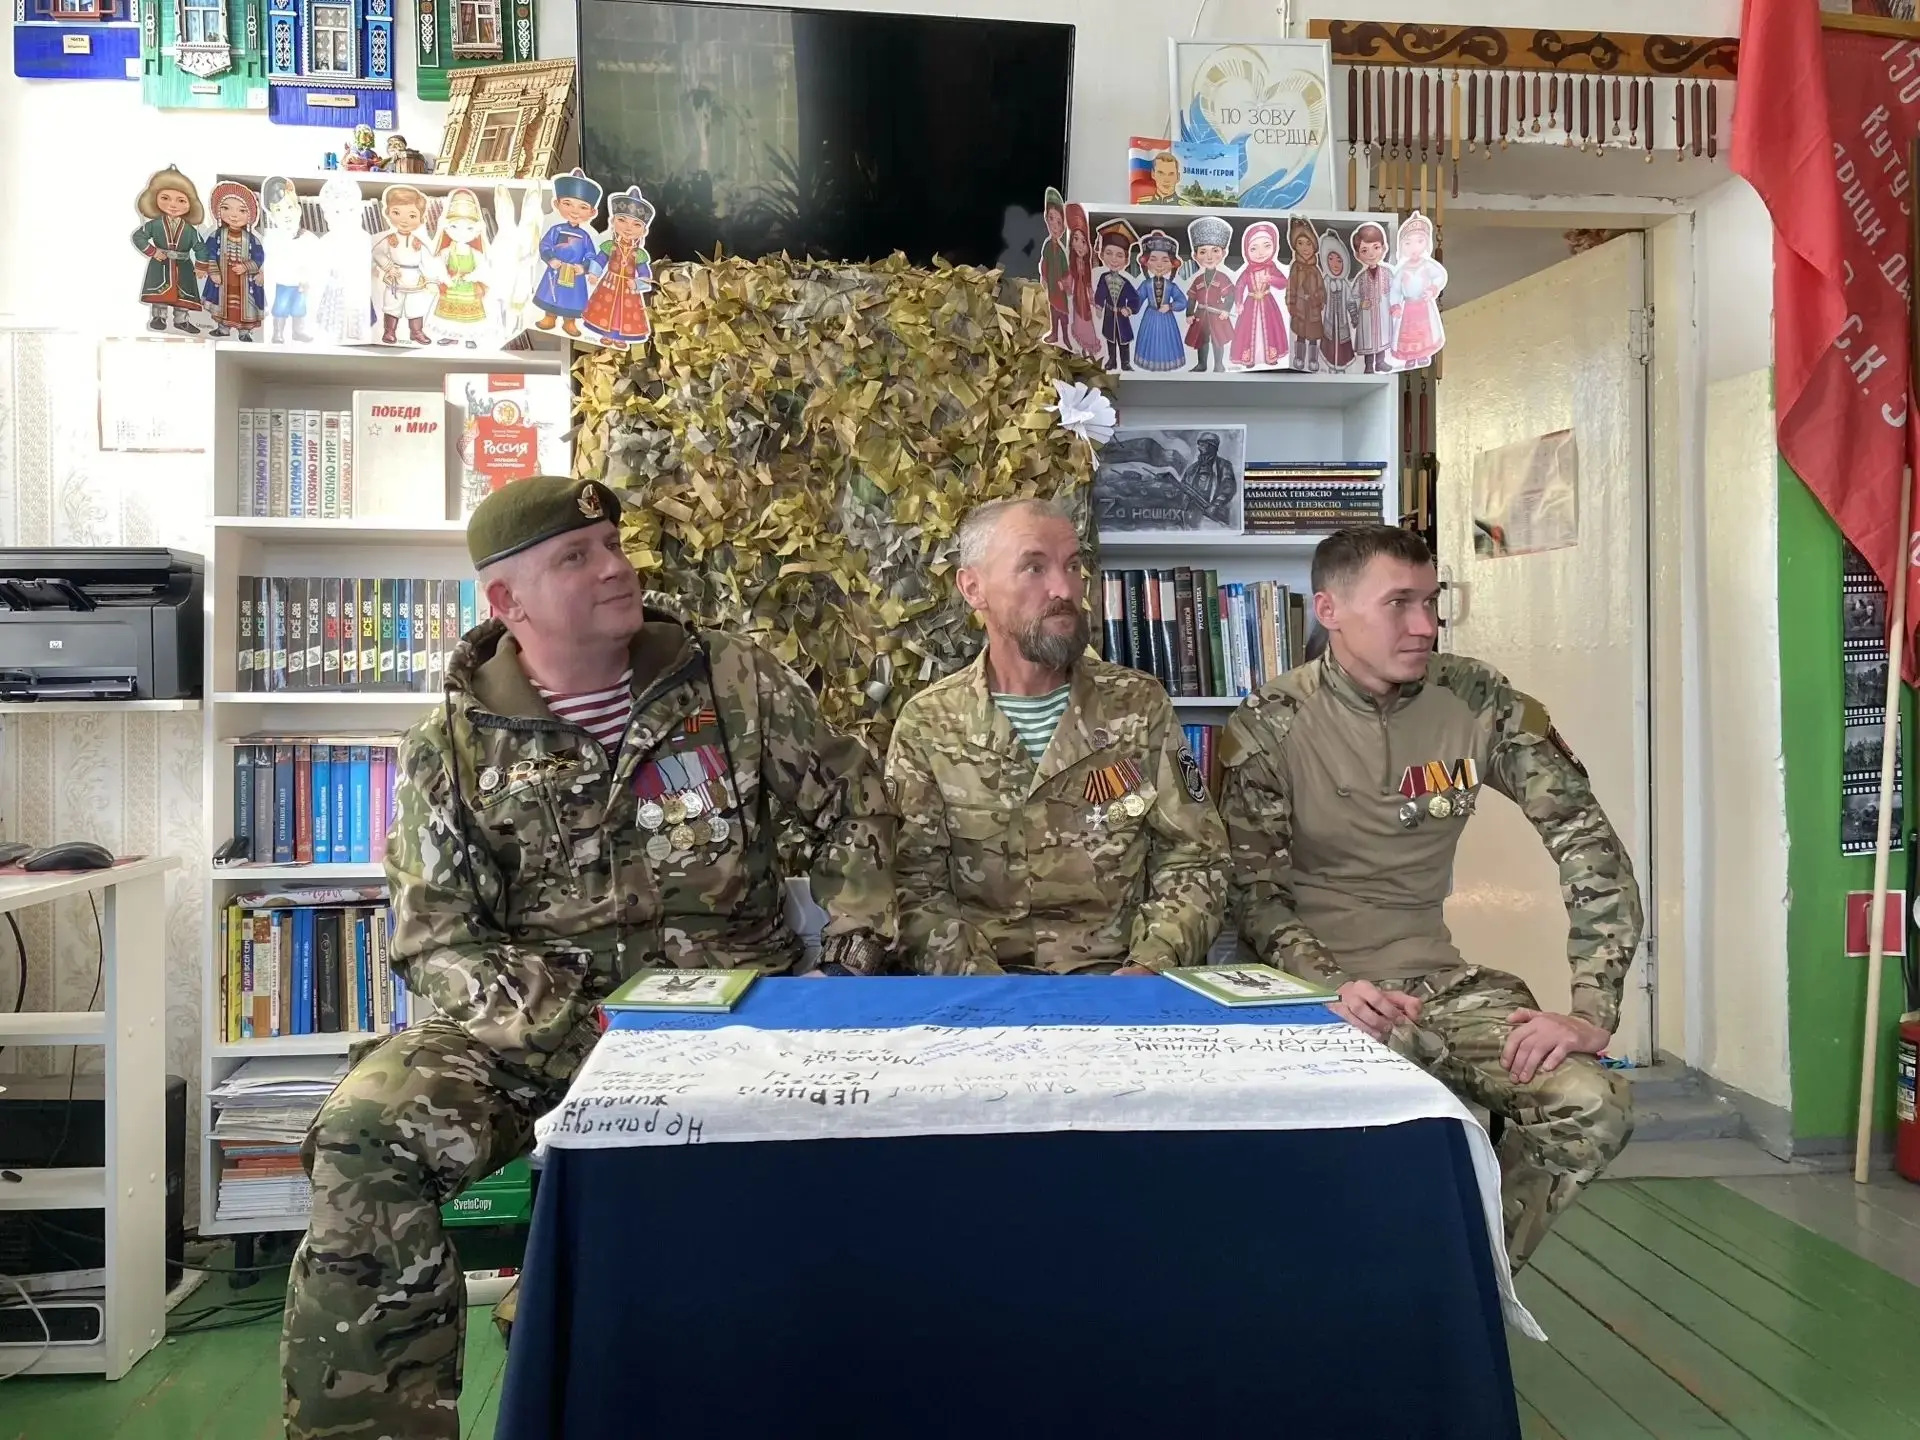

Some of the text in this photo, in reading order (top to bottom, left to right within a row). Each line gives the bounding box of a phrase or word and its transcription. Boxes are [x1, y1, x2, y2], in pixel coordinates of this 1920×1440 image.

[1221, 107, 1297, 126] ПО ЗОВУ
[1253, 128, 1319, 147] СЕРДЦА
[371, 405, 421, 419] ПОБЕДА
[406, 422, 439, 434] МИР
[256, 433, 267, 457] МИР
[308, 440, 318, 462] МИР
[326, 440, 336, 463] МИР
[256, 460, 267, 505] ПОЗНАЮ
[290, 433, 302, 516] Я ПОЗНАЮ МИР
[307, 464, 318, 506] ПОЗНАЮ
[324, 466, 335, 509] ПОЗНАЮ
[1290, 490, 1332, 498] ГЕНЭКСПО
[453, 1197, 493, 1211] SvetoCopy
